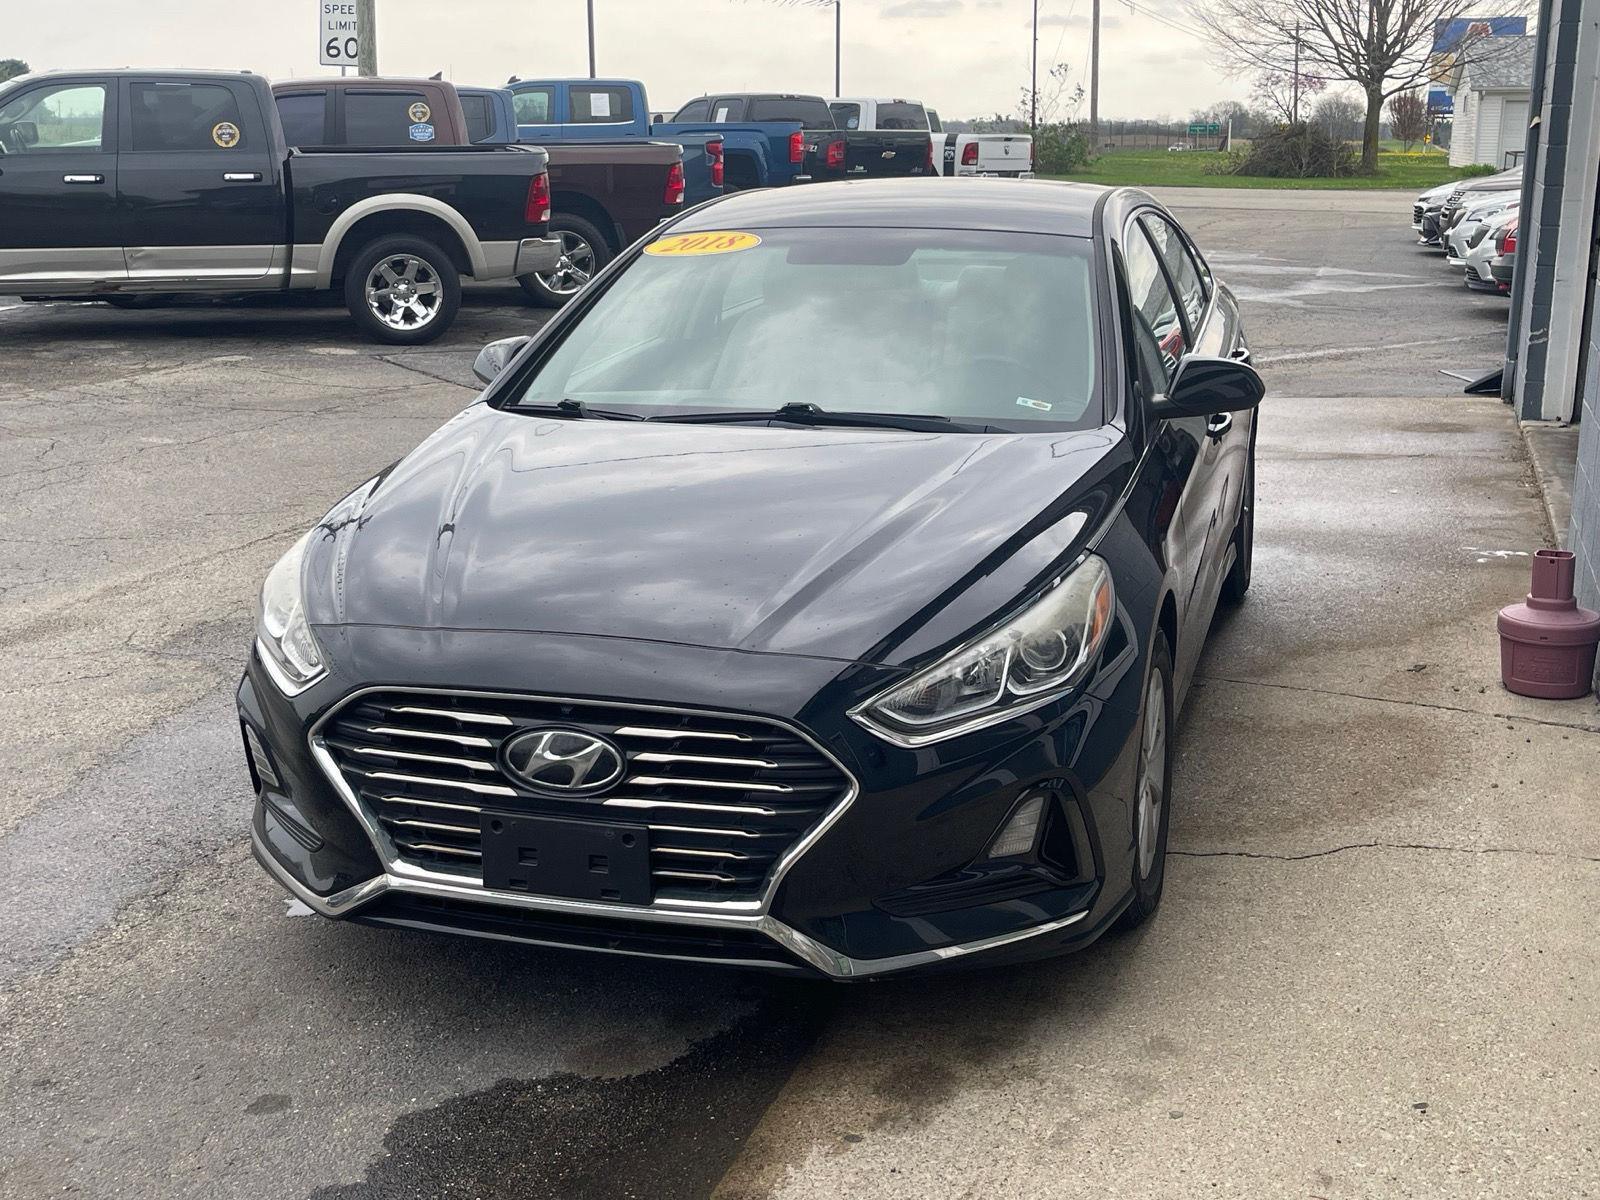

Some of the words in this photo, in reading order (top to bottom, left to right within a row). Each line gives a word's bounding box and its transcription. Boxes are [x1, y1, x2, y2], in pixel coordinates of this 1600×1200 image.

[324, 4, 355, 15] SPEE
[328, 21, 357, 31] LIMIT
[326, 37, 358, 59] 60
[659, 235, 746, 253] 2018
